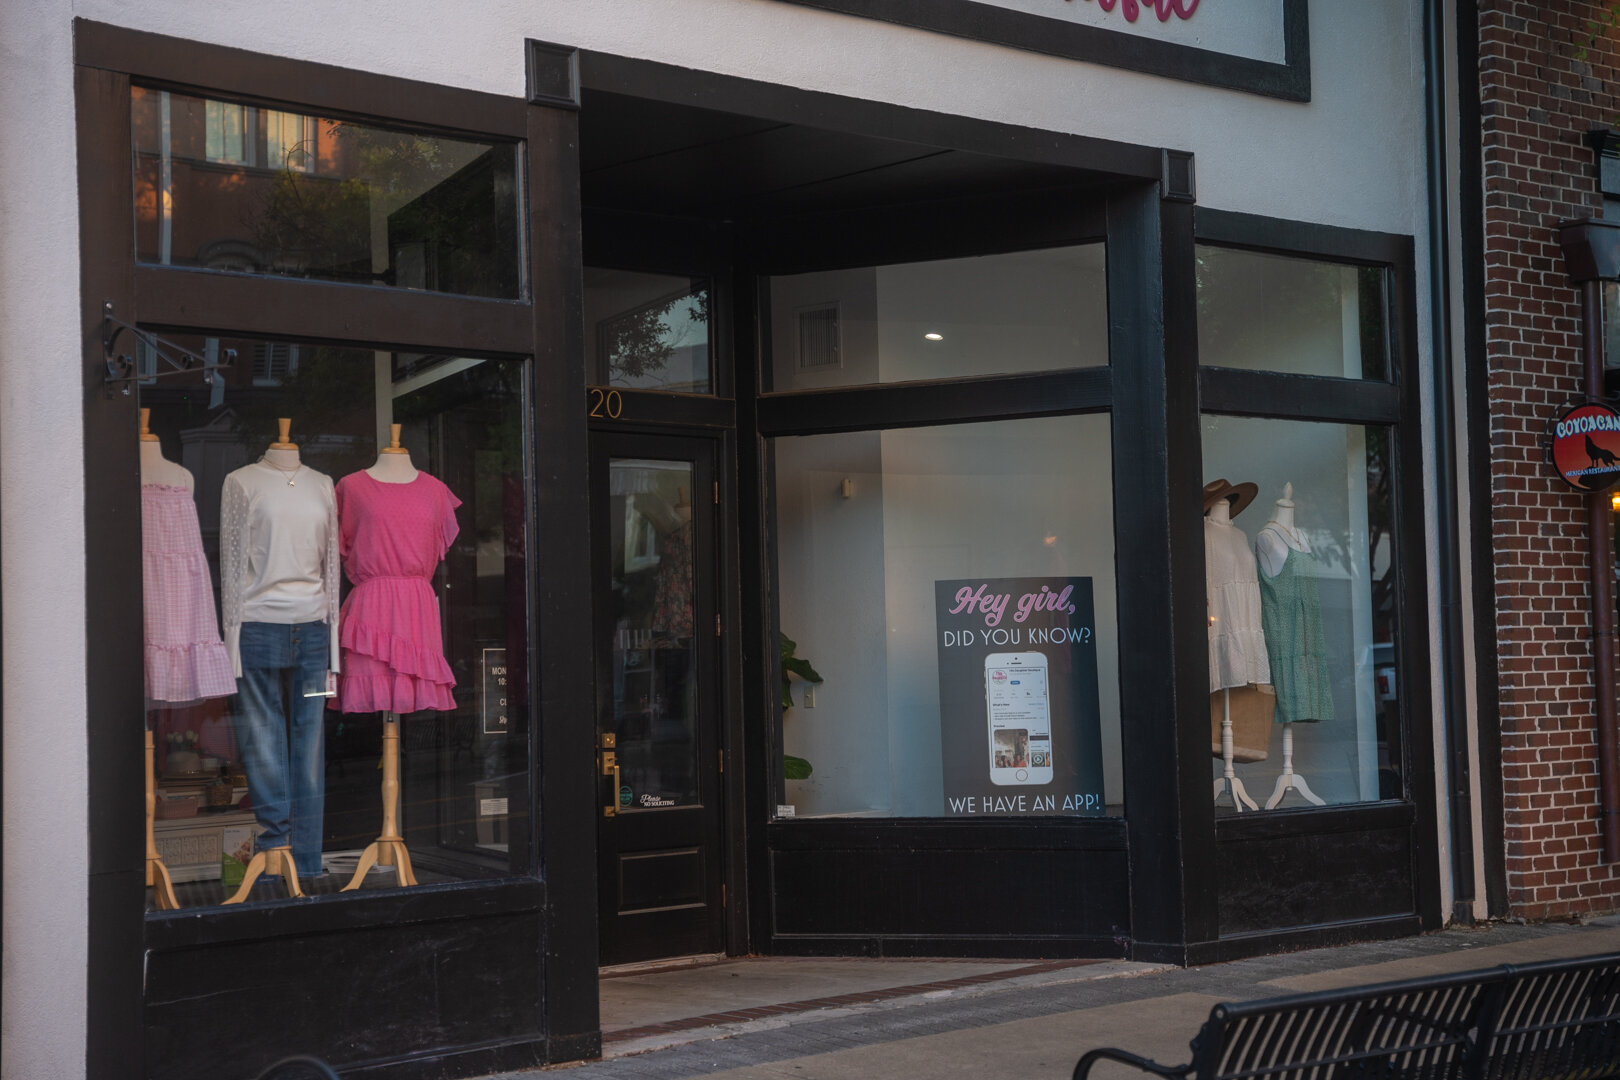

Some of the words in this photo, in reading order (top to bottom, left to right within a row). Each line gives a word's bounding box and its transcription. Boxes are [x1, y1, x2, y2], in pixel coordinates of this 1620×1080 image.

[589, 388, 622, 419] 20
[949, 584, 1011, 627] Hey
[1013, 584, 1076, 623] girl,
[944, 630, 974, 647] DID
[980, 628, 1020, 646] YOU
[1028, 627, 1091, 645] KNOW?
[949, 796, 976, 813] WE
[983, 795, 1027, 813] HAVE
[1032, 794, 1055, 811] AN
[1062, 793, 1100, 811] APP!
